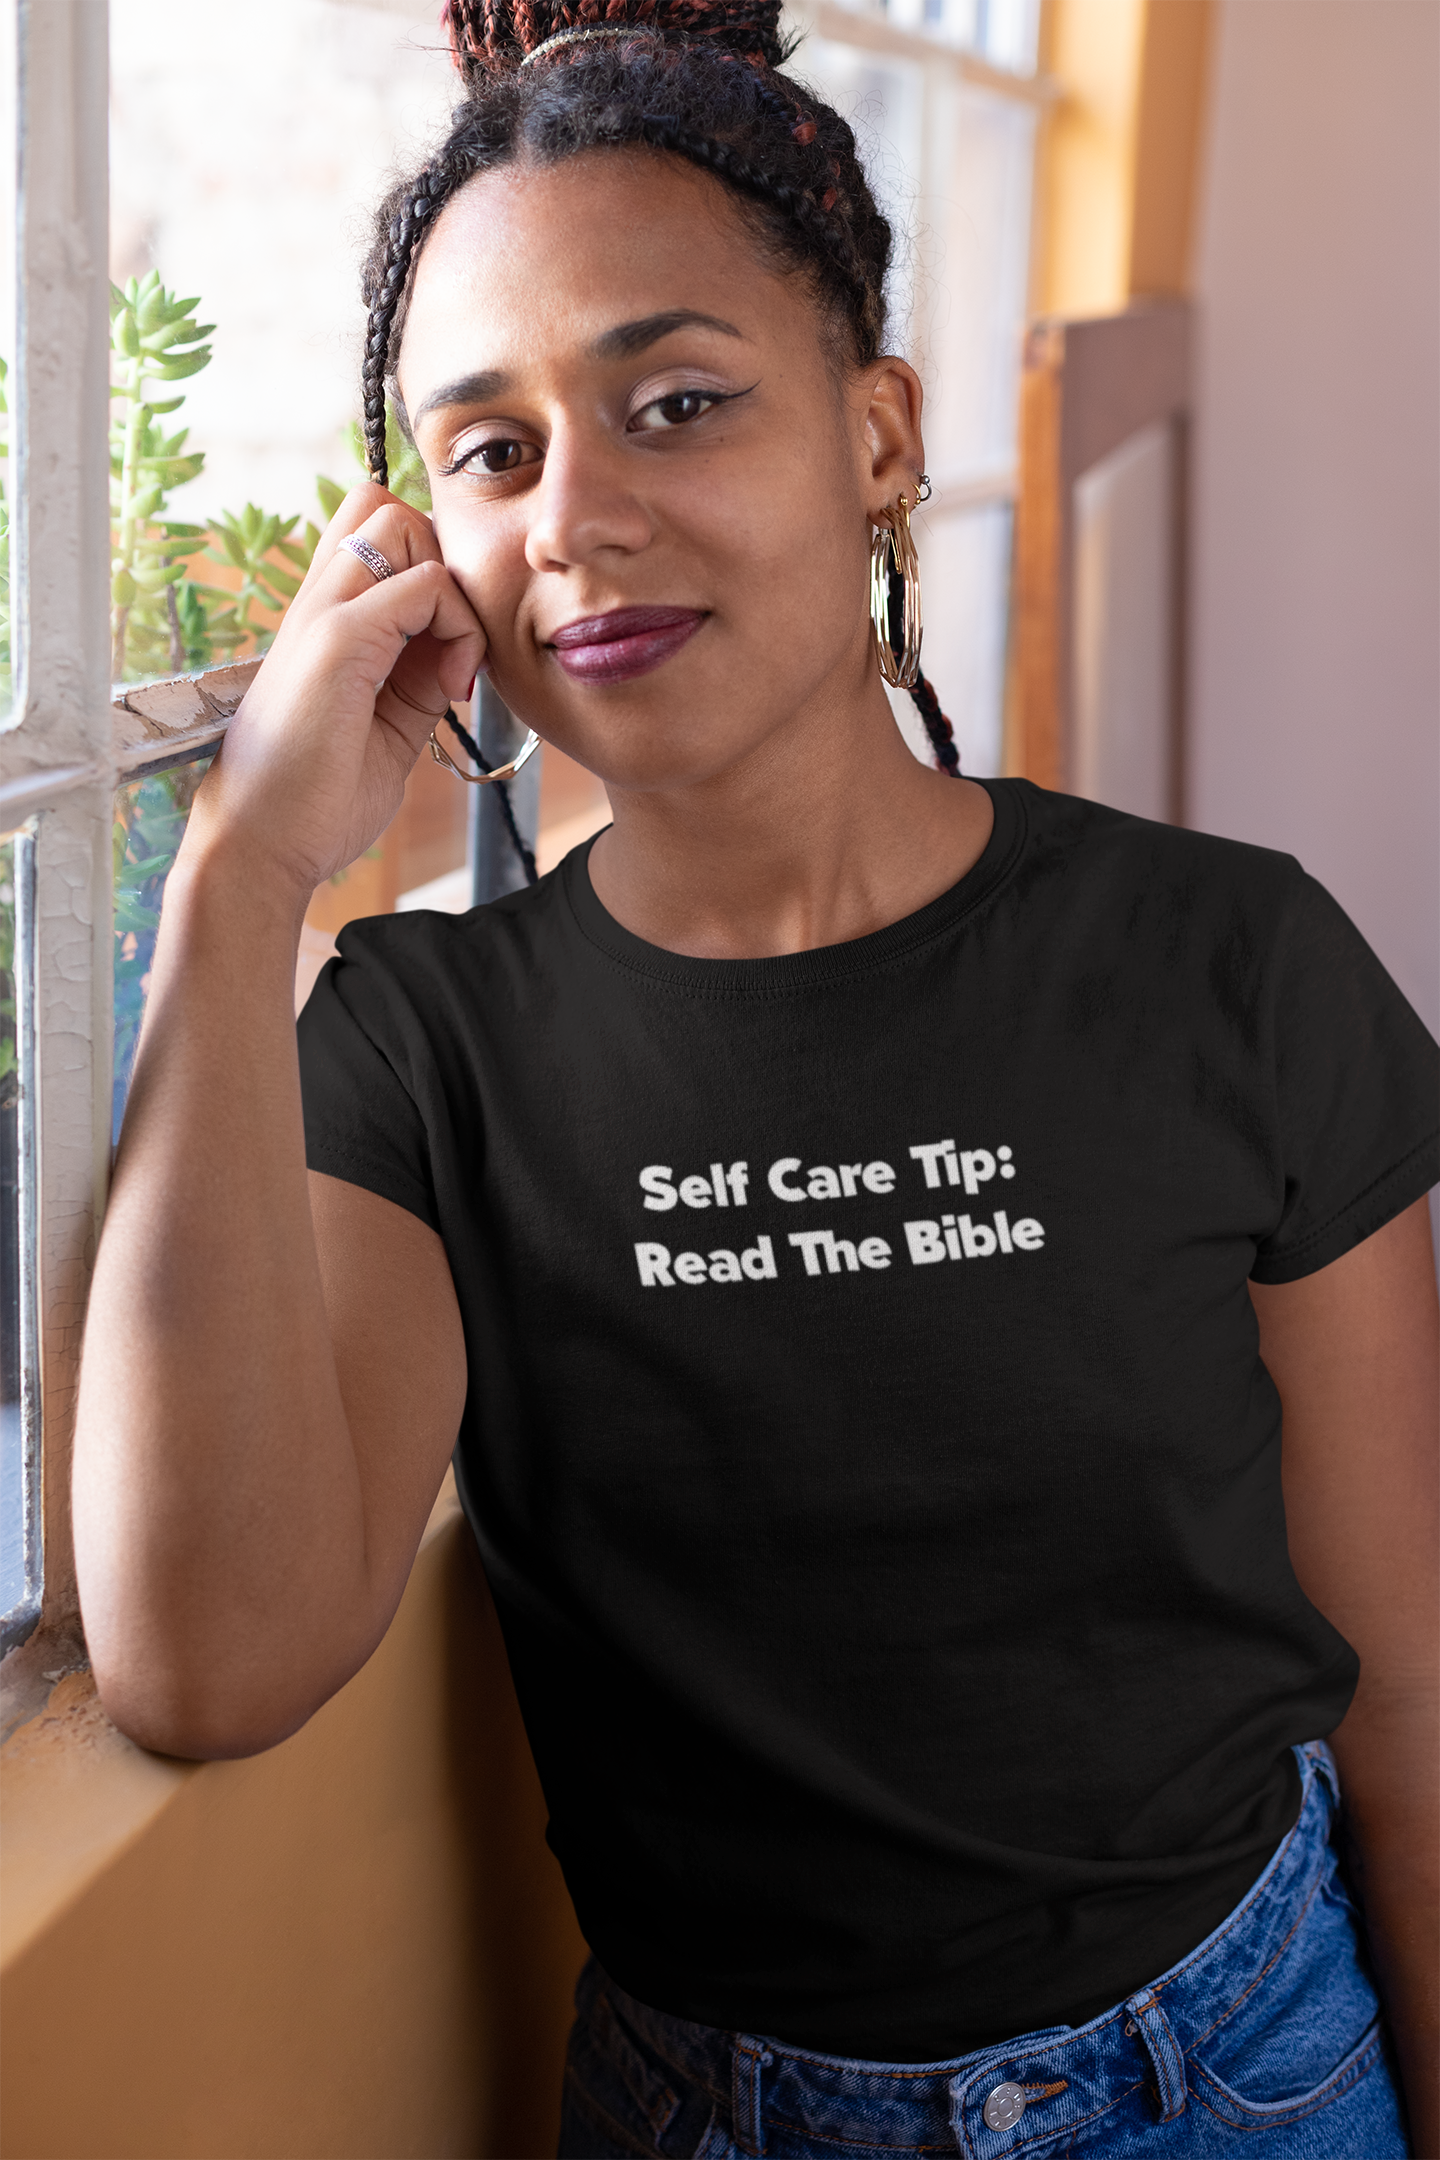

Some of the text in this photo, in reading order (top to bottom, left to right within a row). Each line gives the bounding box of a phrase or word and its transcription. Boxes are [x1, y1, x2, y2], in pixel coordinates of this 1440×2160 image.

[638, 1138, 1016, 1212] Self Care Tip:
[634, 1210, 1045, 1287] Read The Bible
